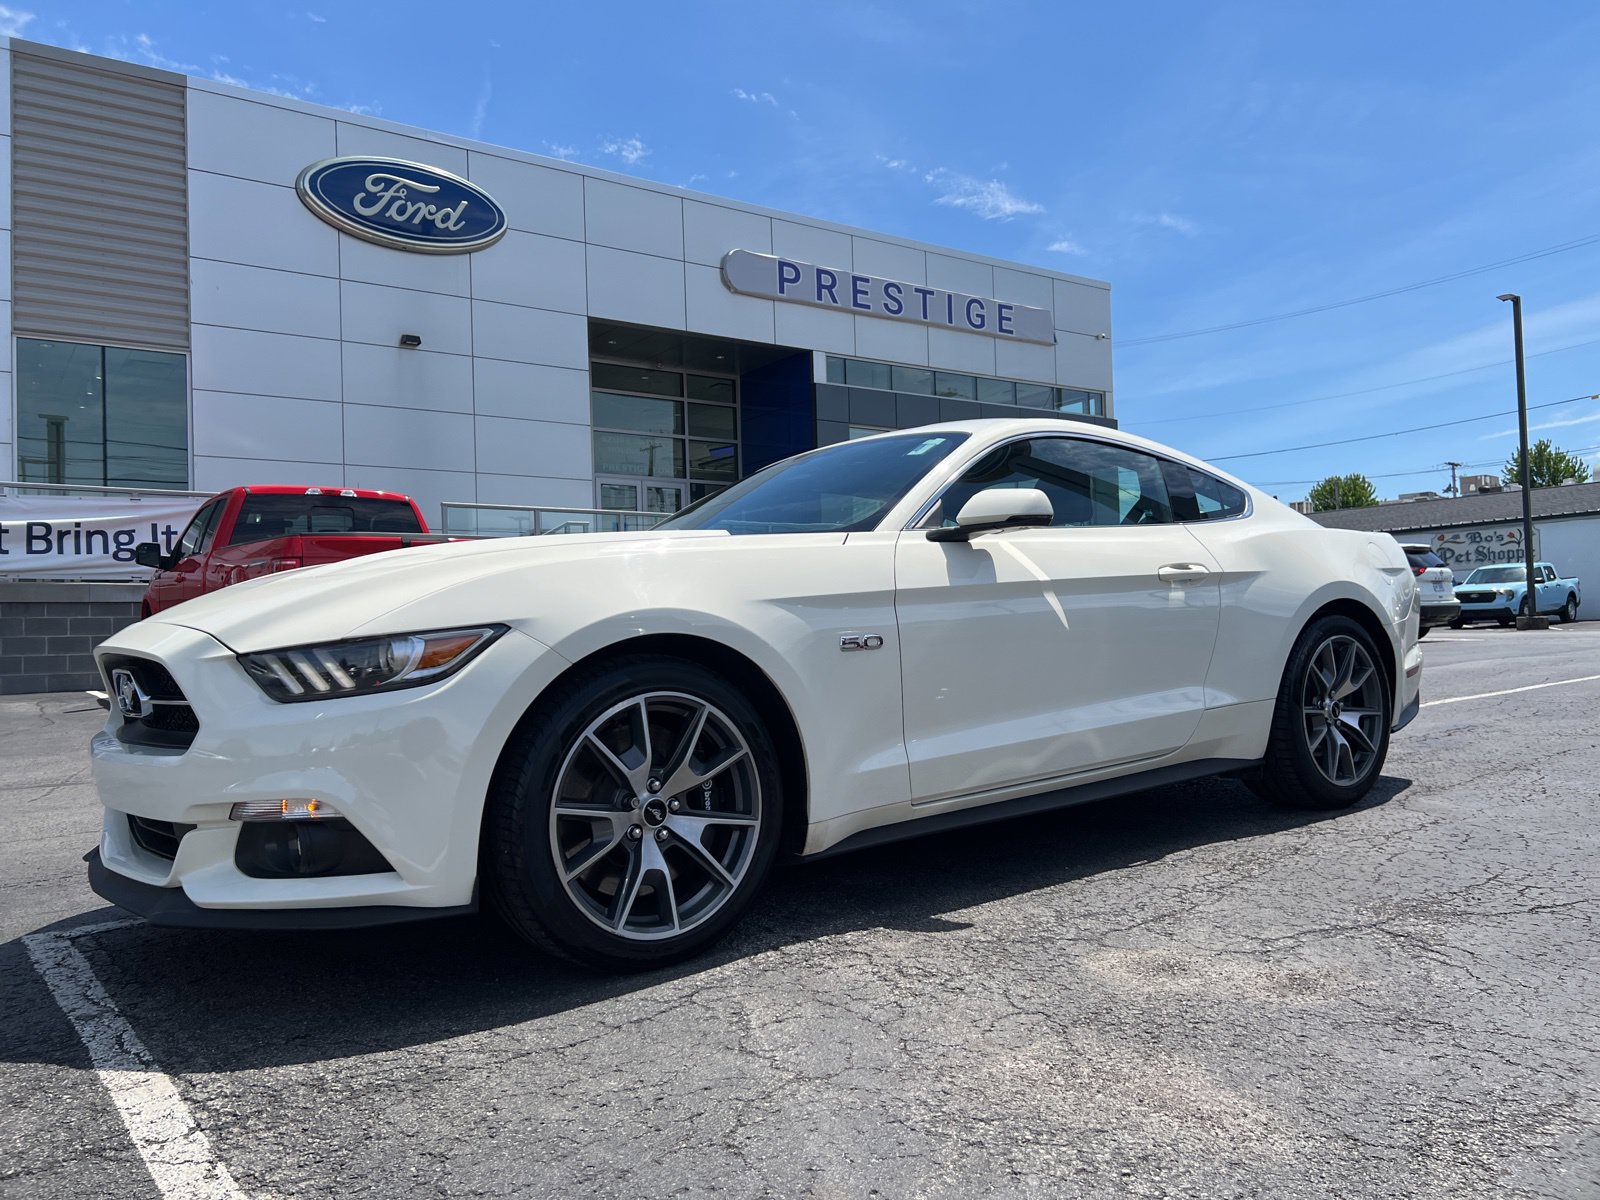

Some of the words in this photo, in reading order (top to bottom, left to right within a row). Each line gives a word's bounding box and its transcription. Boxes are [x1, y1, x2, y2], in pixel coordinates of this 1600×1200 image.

[353, 173, 468, 231] Ford
[777, 259, 1015, 336] PRESTIGE
[26, 522, 137, 562] Bring
[151, 523, 178, 555] It
[1436, 547, 1472, 566] Pet
[1474, 545, 1535, 563] Shopp
[1466, 531, 1504, 546] Bo's
